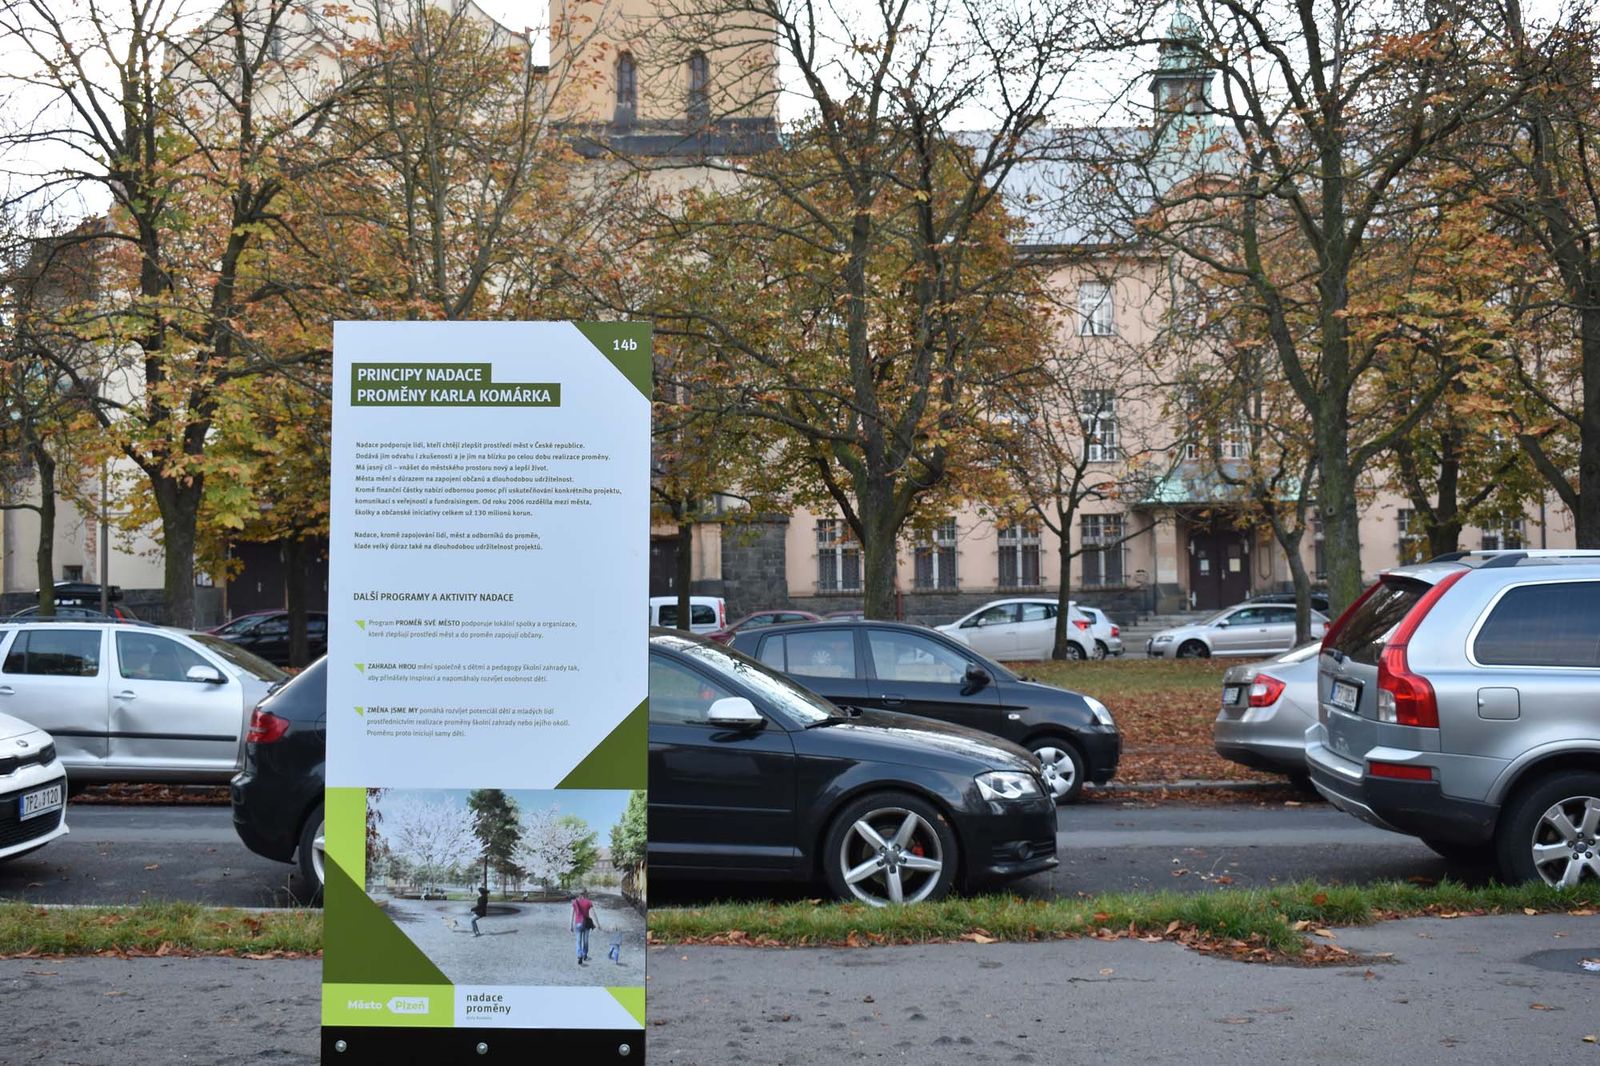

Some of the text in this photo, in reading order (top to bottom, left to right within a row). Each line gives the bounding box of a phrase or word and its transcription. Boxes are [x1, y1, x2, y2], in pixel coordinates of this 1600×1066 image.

[613, 339, 637, 351] 14b
[358, 368, 482, 381] PRINCIPY NADACE
[357, 386, 551, 402] PROMĚNY KARLA KOMÁRKA
[380, 441, 411, 450] podporuje
[413, 441, 425, 450] lidí,
[442, 441, 460, 450] chtějí
[461, 441, 482, 450] zlepšit
[483, 441, 511, 450] prostředí
[535, 441, 553, 449] České
[554, 441, 585, 450] republice.
[380, 452, 389, 461] jim
[419, 452, 452, 460] zkušenosti
[459, 452, 466, 461] je
[467, 452, 476, 461] jim
[582, 453, 610, 462] proměny.
[367, 463, 383, 472] jasný
[399, 463, 419, 471] vnášet
[465, 464, 491, 473] prostoru
[494, 464, 508, 473] nový
[515, 464, 530, 473] lepší
[434, 475, 461, 484] zapojení
[535, 475, 574, 483] udržitelnost.
[402, 486, 423, 495] částky
[498, 486, 507, 495] při
[509, 486, 553, 494] uskutečňování
[594, 487, 622, 496] projektu,
[397, 497, 428, 506] veřejností
[571, 498, 592, 507] města,
[355, 509, 375, 517] školky
[412, 509, 440, 518] iniciativy
[354, 531, 379, 540] Nadace,
[401, 531, 434, 540] zapojování
[436, 531, 448, 540] lidí,
[472, 531, 503, 539] odborníků
[505, 531, 513, 539] do
[515, 532, 540, 540] proměn,
[372, 542, 388, 551] velký
[433, 542, 474, 550] dlouhodobou
[515, 543, 543, 551] projektů.
[353, 591, 514, 601] DALŠÍ PROGRAMY A AKTIVITY NADACE
[466, 993, 503, 1002] nadace
[348, 1000, 425, 1010] Město Plzeň
[466, 1004, 511, 1015] proměny
